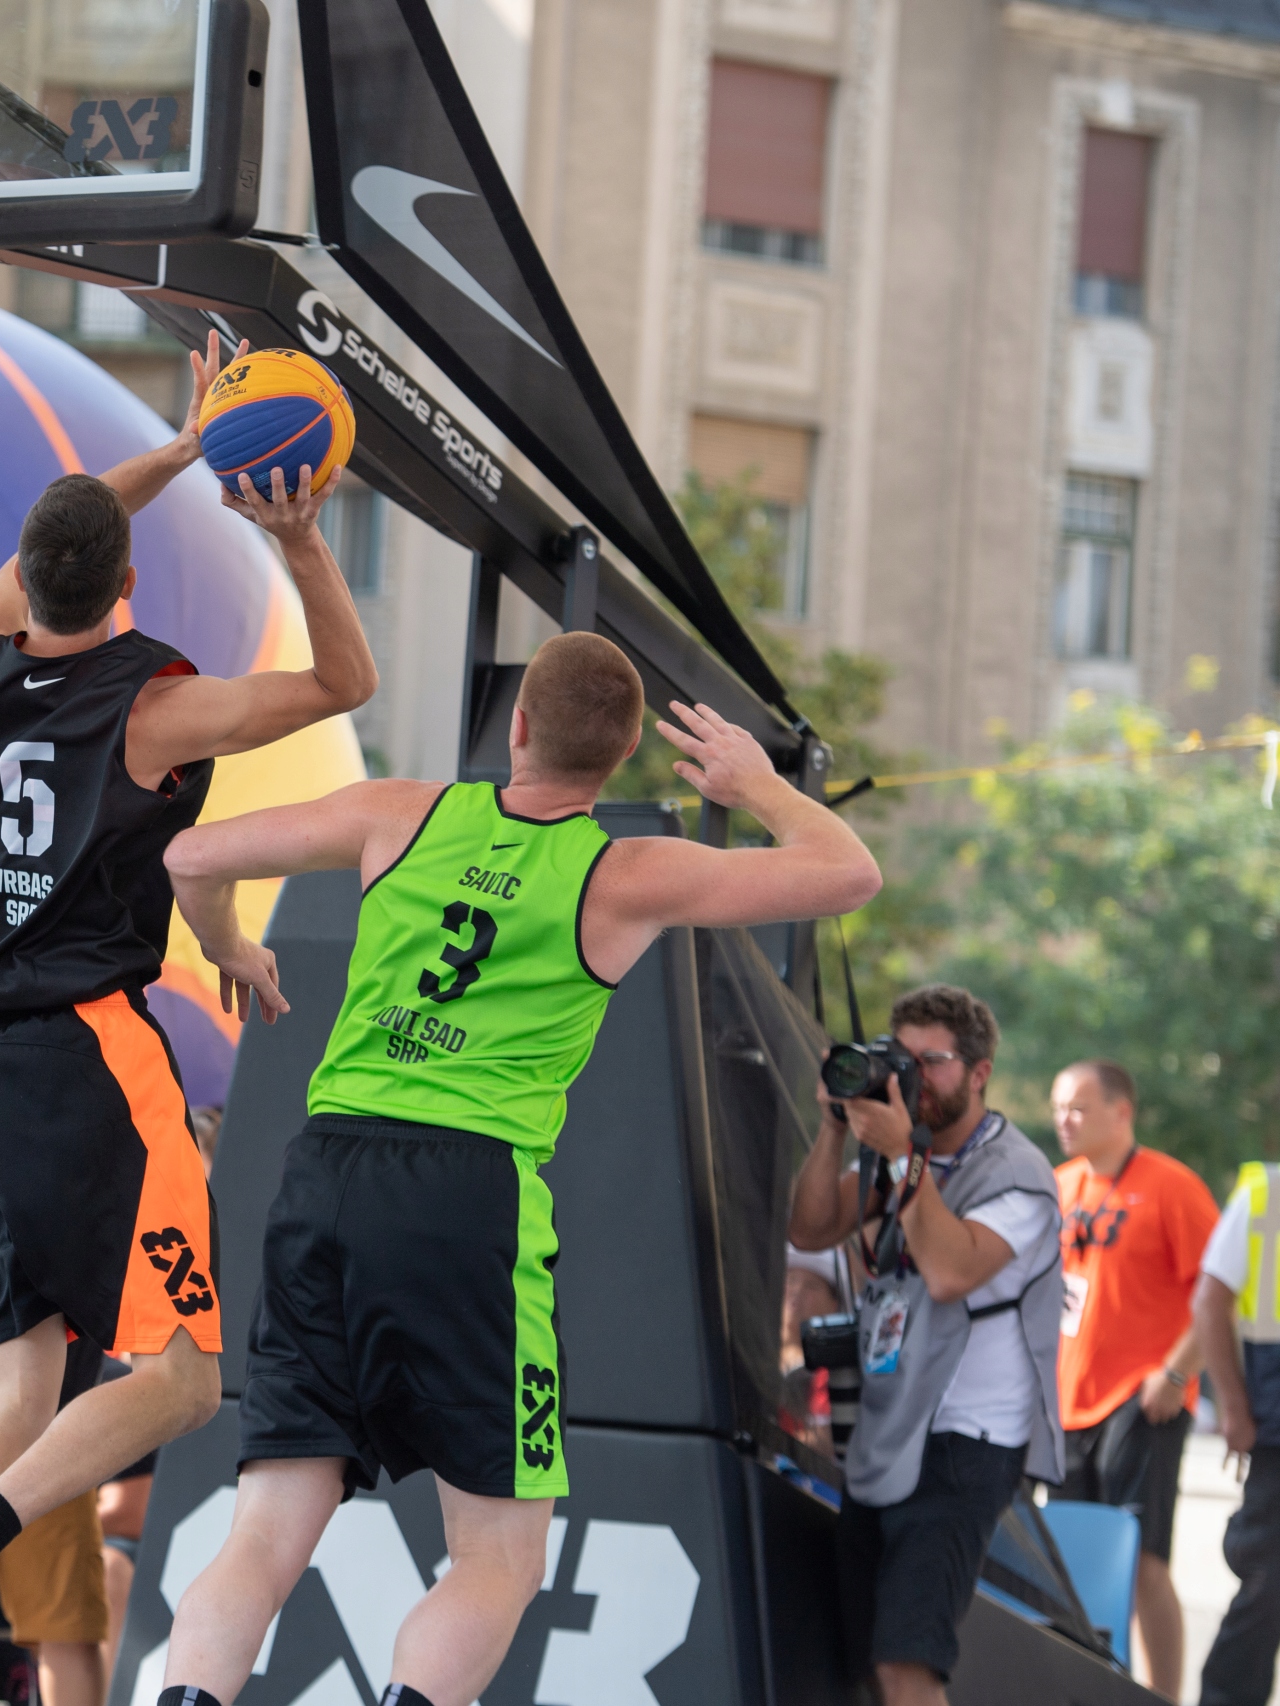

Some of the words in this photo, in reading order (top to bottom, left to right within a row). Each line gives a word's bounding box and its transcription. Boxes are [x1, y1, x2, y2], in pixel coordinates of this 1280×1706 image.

[341, 328, 431, 424] Schelde
[431, 413, 503, 490] Sports
[0, 741, 55, 857] 5
[417, 900, 498, 1004] 3
[420, 1016, 467, 1054] SAD
